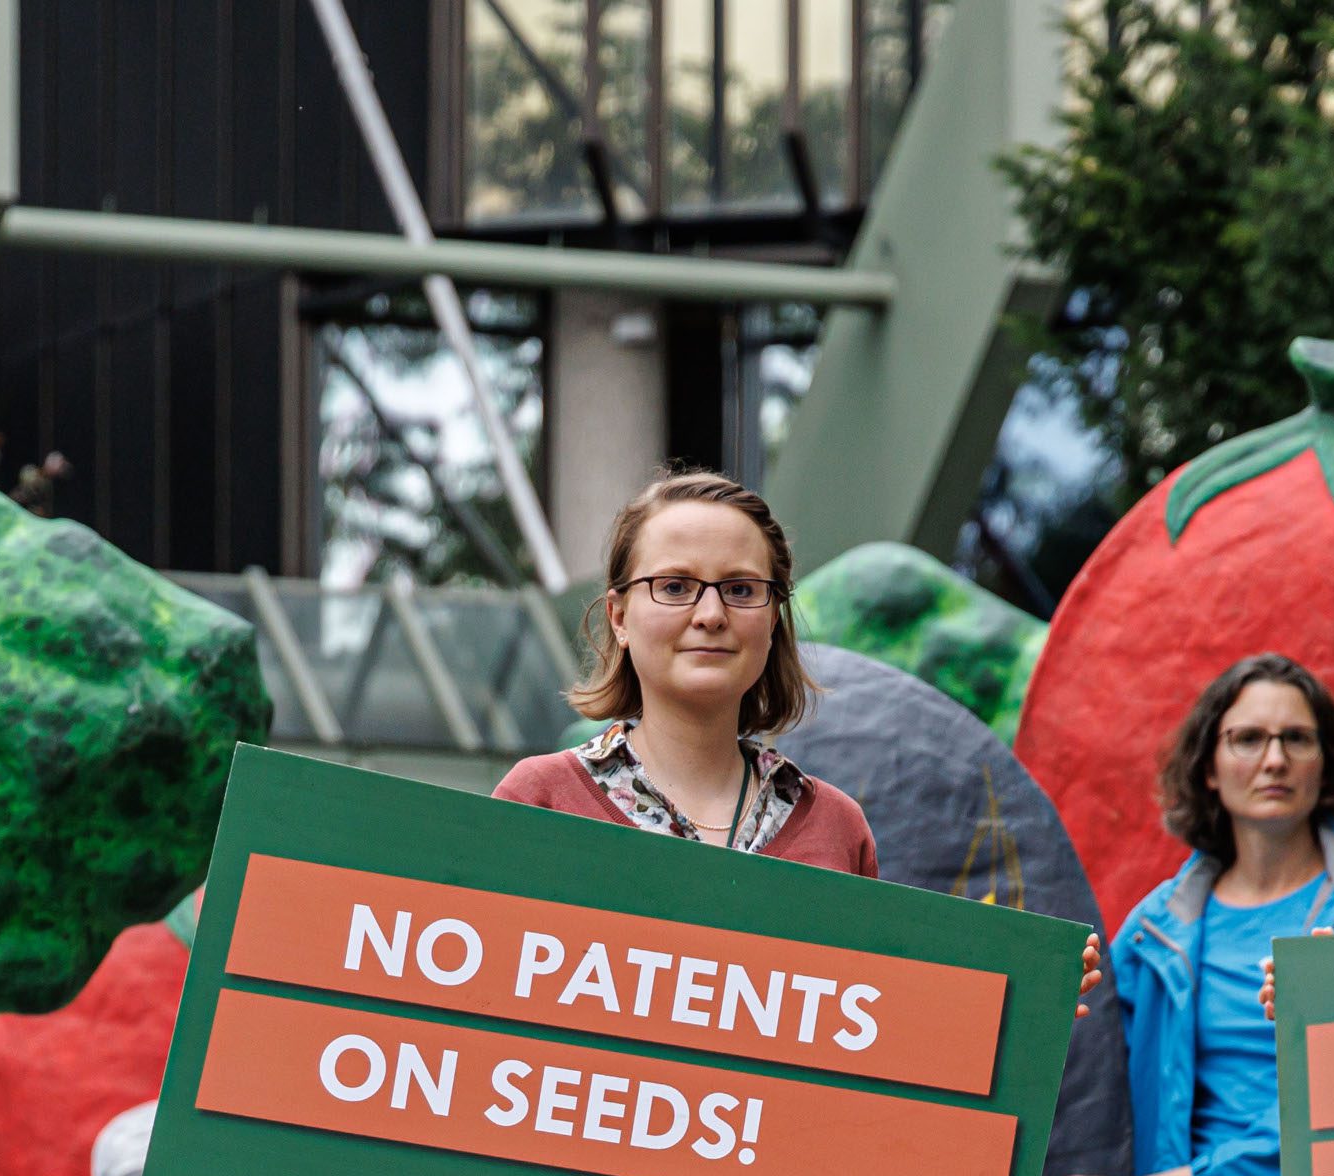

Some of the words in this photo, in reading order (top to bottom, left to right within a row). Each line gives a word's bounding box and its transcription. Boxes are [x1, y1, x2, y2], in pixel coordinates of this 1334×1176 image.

[345, 904, 483, 985] NO
[515, 932, 881, 1050] PATENTS
[320, 1035, 458, 1116] ON
[484, 1060, 763, 1164] SEEDS!
